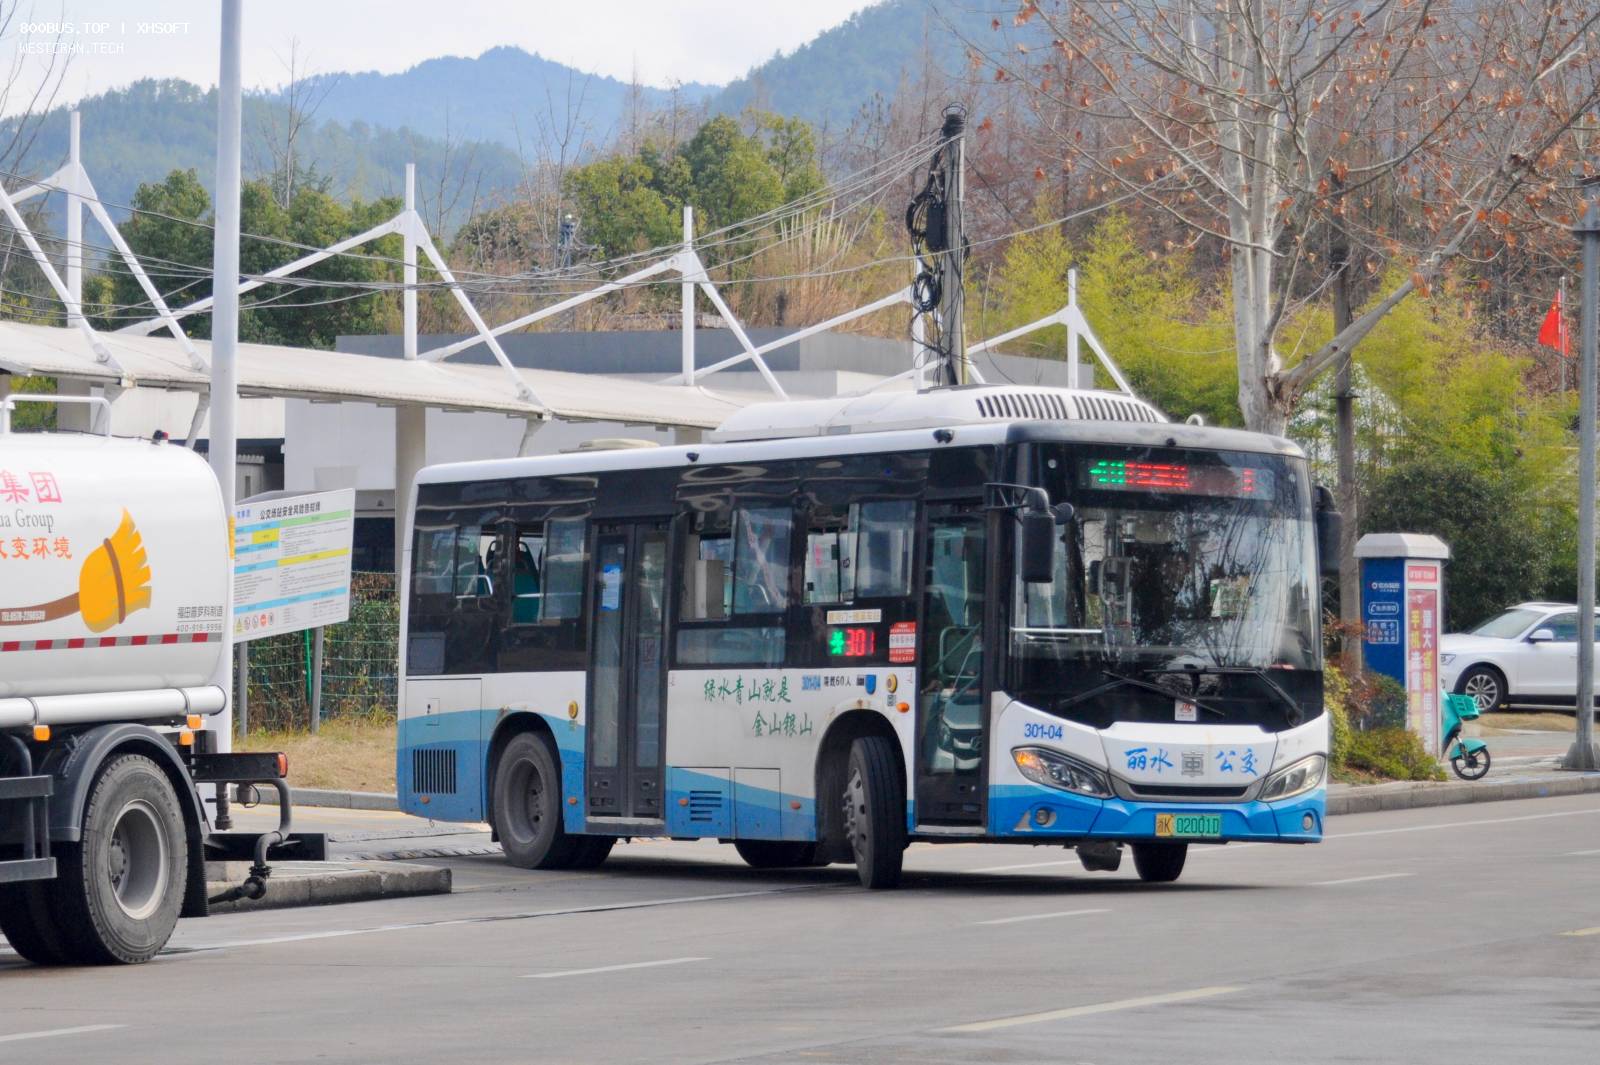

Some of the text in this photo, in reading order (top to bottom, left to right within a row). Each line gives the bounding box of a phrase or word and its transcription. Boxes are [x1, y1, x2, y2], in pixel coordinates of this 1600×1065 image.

[0, 469, 63, 504] 集团
[15, 508, 54, 534] Group
[845, 628, 876, 657] 301
[704, 675, 792, 705] 绿水青山就是
[752, 711, 813, 737] 金山银山
[1024, 723, 1063, 739] 301-04
[1124, 748, 1173, 774] 丽水
[1215, 748, 1259, 776] 公交
